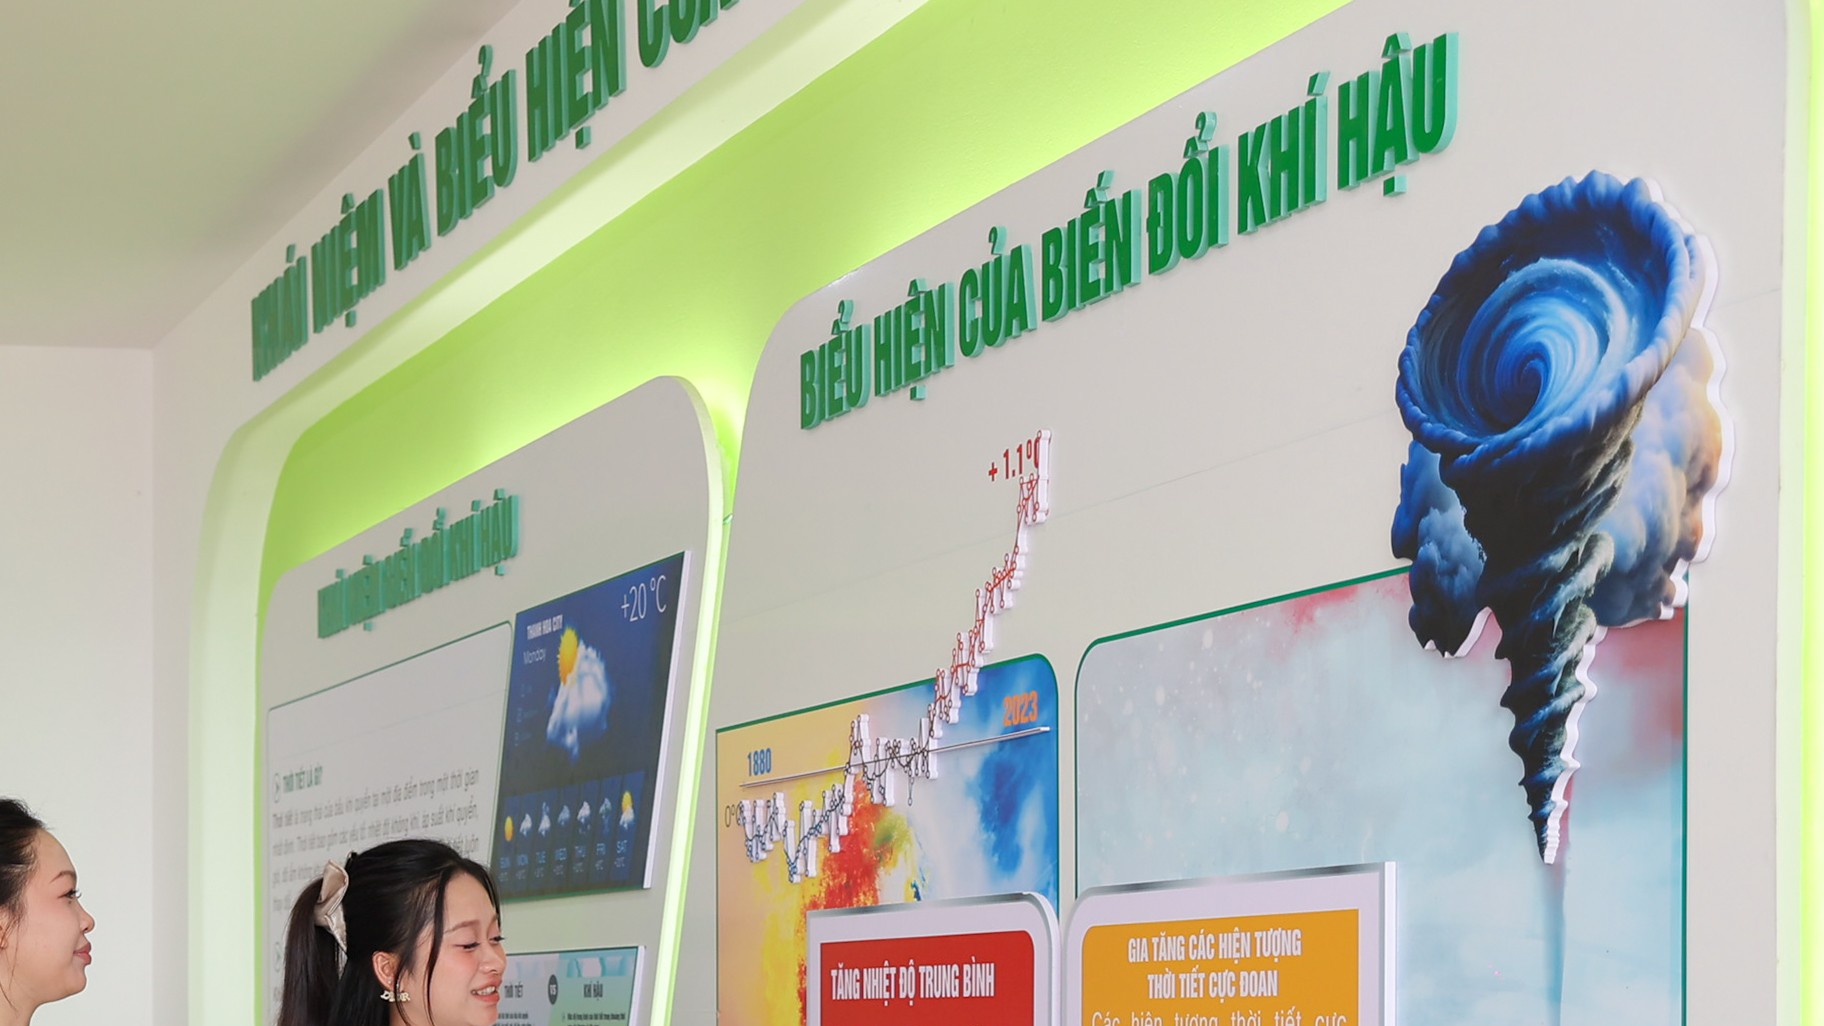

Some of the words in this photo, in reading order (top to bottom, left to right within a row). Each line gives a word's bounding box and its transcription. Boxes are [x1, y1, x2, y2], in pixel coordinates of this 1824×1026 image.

[388, 132, 432, 271] VÀ
[435, 44, 518, 237] BIỂU
[525, 0, 626, 162] HIỆN
[801, 300, 871, 429] BIỂU
[874, 279, 955, 400] HIỆN
[959, 227, 1037, 357] CỦA
[1042, 170, 1142, 321] BIẾN
[1146, 113, 1229, 275] ĐỔI
[1238, 73, 1329, 235] KHÍ
[1338, 33, 1458, 197] HẬU
[1003, 690, 1039, 727] 2023
[747, 747, 772, 777] 1880
[1127, 937, 1149, 962] GIA
[1151, 931, 1185, 961] TĂNG
[1188, 928, 1215, 960] CÁC
[1218, 927, 1251, 964] HIỆN
[1253, 927, 1302, 962] TƯỢNG
[830, 962, 860, 1000] TĂNG
[862, 959, 896, 1006] NHIỆT
[898, 958, 915, 1006] ĐỘ
[918, 963, 959, 998] TRUNG
[962, 955, 994, 997] BÌNH
[1147, 967, 1176, 998] THỜI
[1178, 966, 1206, 998] TIẾT
[1208, 969, 1236, 1003] CỰC
[1239, 969, 1278, 997] ĐOAN
